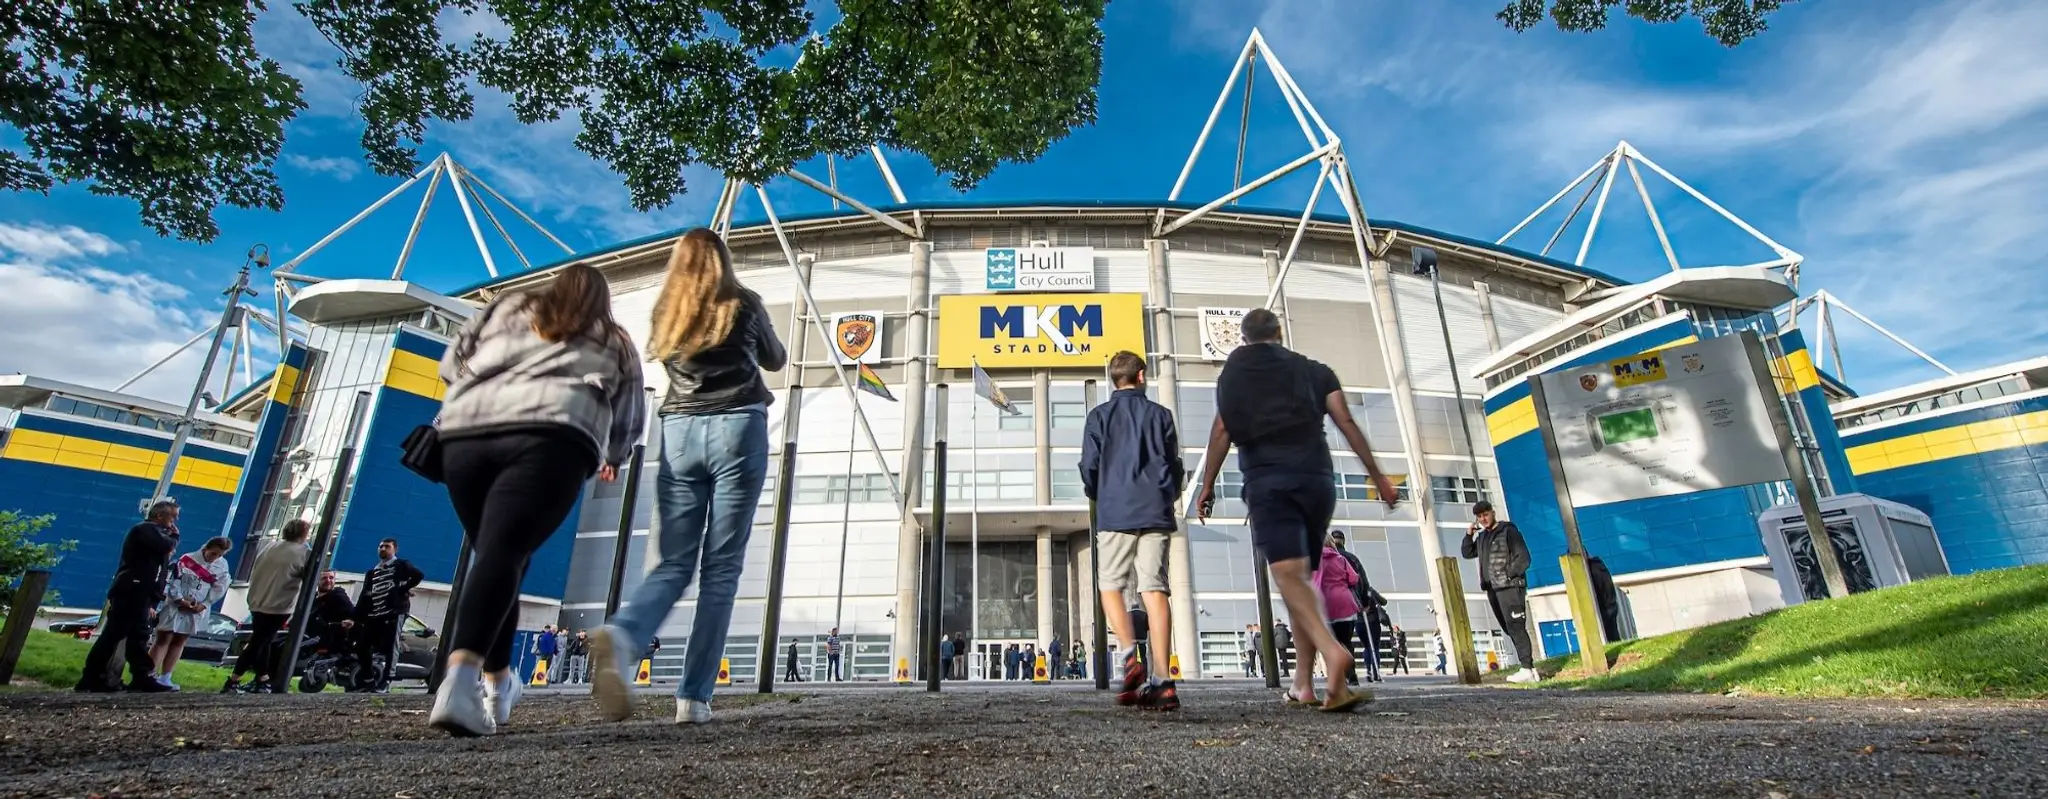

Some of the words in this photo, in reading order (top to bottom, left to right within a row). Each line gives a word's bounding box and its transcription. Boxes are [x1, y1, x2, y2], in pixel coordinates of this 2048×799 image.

[1020, 251, 1064, 270] Hull
[1020, 276, 1044, 288] City
[1048, 275, 1092, 286] Council
[980, 304, 1103, 355] MKM
[993, 343, 1091, 354] STADIUM
